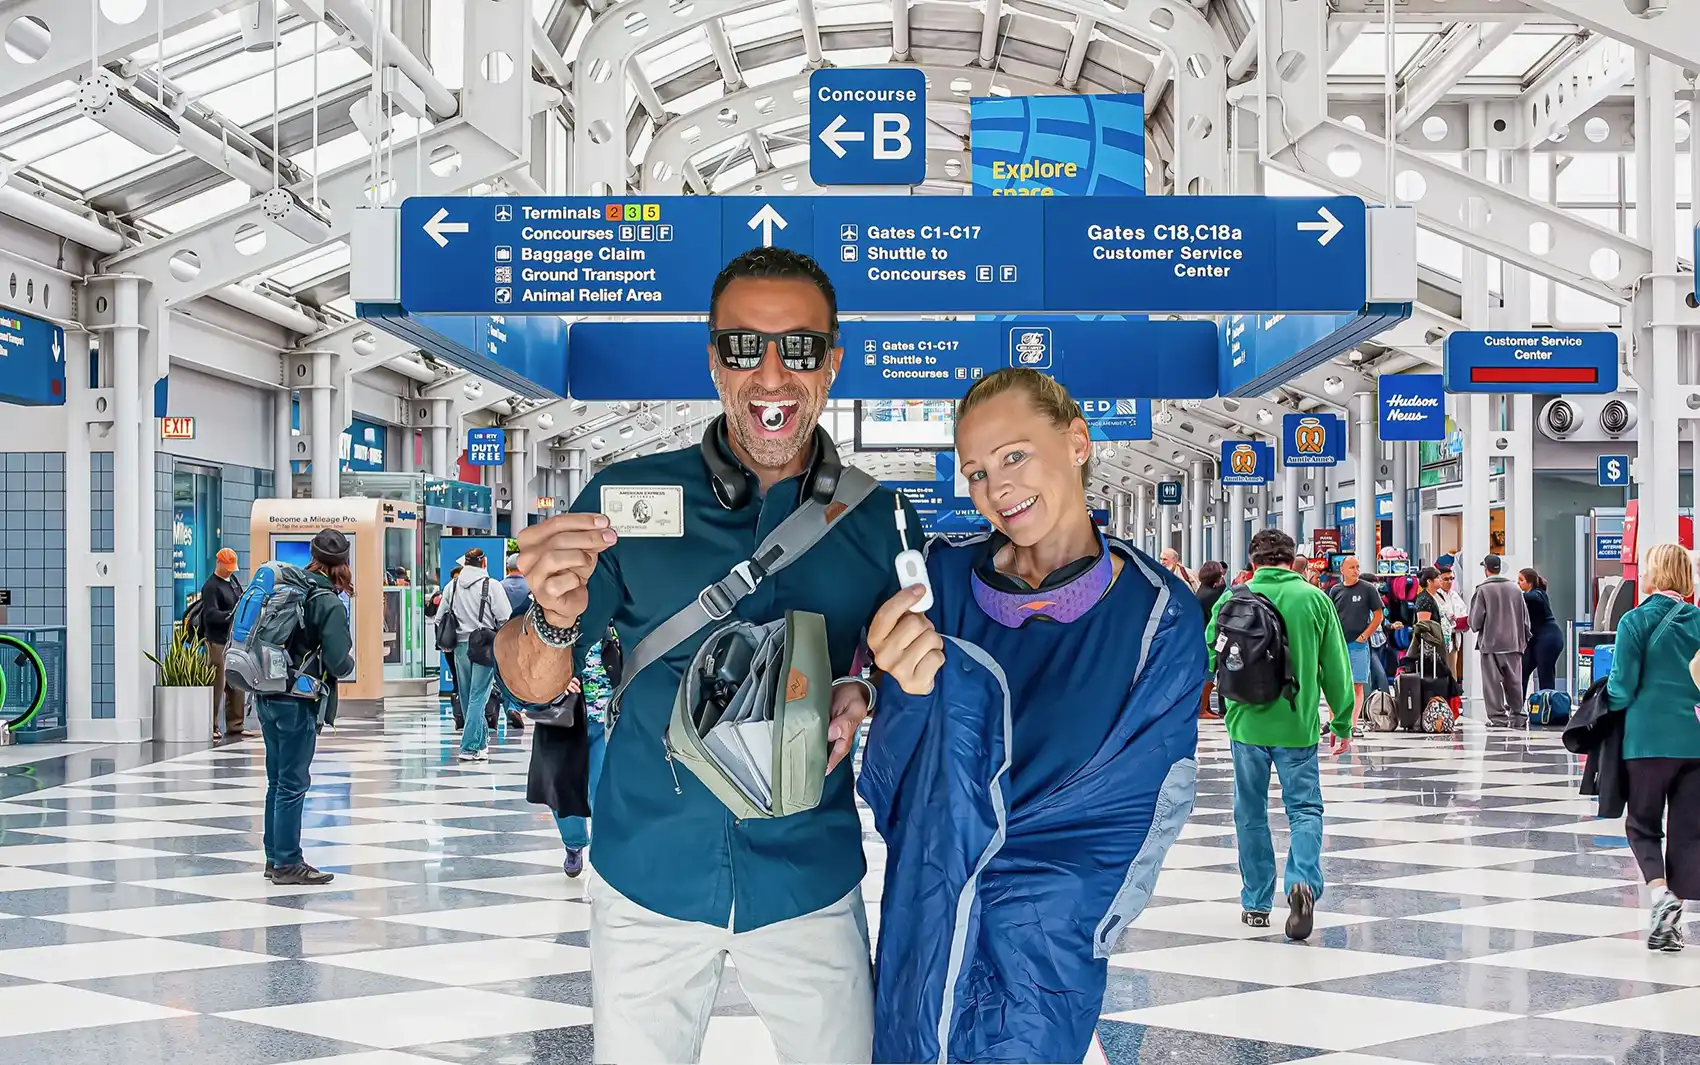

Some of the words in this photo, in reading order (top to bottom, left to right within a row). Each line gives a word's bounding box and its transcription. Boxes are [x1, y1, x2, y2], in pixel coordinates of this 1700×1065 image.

[818, 87, 917, 102] Concourse
[873, 112, 912, 160] B
[993, 159, 1077, 182] Explore
[522, 206, 601, 219] Terminals
[522, 227, 614, 240] Concourses
[868, 225, 917, 240] Gates
[921, 225, 981, 240] C1-C17
[1087, 225, 1145, 240] Gates
[1153, 225, 1243, 243] C18,C18a
[522, 248, 593, 262] Baggage
[599, 248, 645, 260] Claim
[868, 246, 925, 260] Shuttle
[931, 247, 948, 260] to
[1093, 246, 1174, 260] Customer
[1180, 246, 1243, 260] Service
[522, 268, 577, 281] Ground
[582, 268, 656, 283] Transport
[868, 267, 966, 281] Concourses
[1174, 264, 1230, 278] Center
[522, 289, 575, 302] Animal
[579, 289, 622, 302] Relief
[626, 289, 662, 302] Area
[882, 341, 913, 351] Gates
[917, 341, 959, 351] C1-C17
[1484, 336, 1538, 347] Customer
[1541, 336, 1582, 347] Service
[882, 355, 919, 365] Shuttle
[925, 355, 937, 365] to
[1514, 350, 1552, 360] Center
[882, 369, 949, 379] Concourses
[1386, 395, 1438, 407] Hudson
[1387, 410, 1428, 421] News
[164, 418, 191, 434] EXIT
[472, 444, 500, 452] DUTY
[472, 453, 500, 461] FREE
[1607, 459, 1621, 482] $
[310, 516, 340, 524] Mileage
